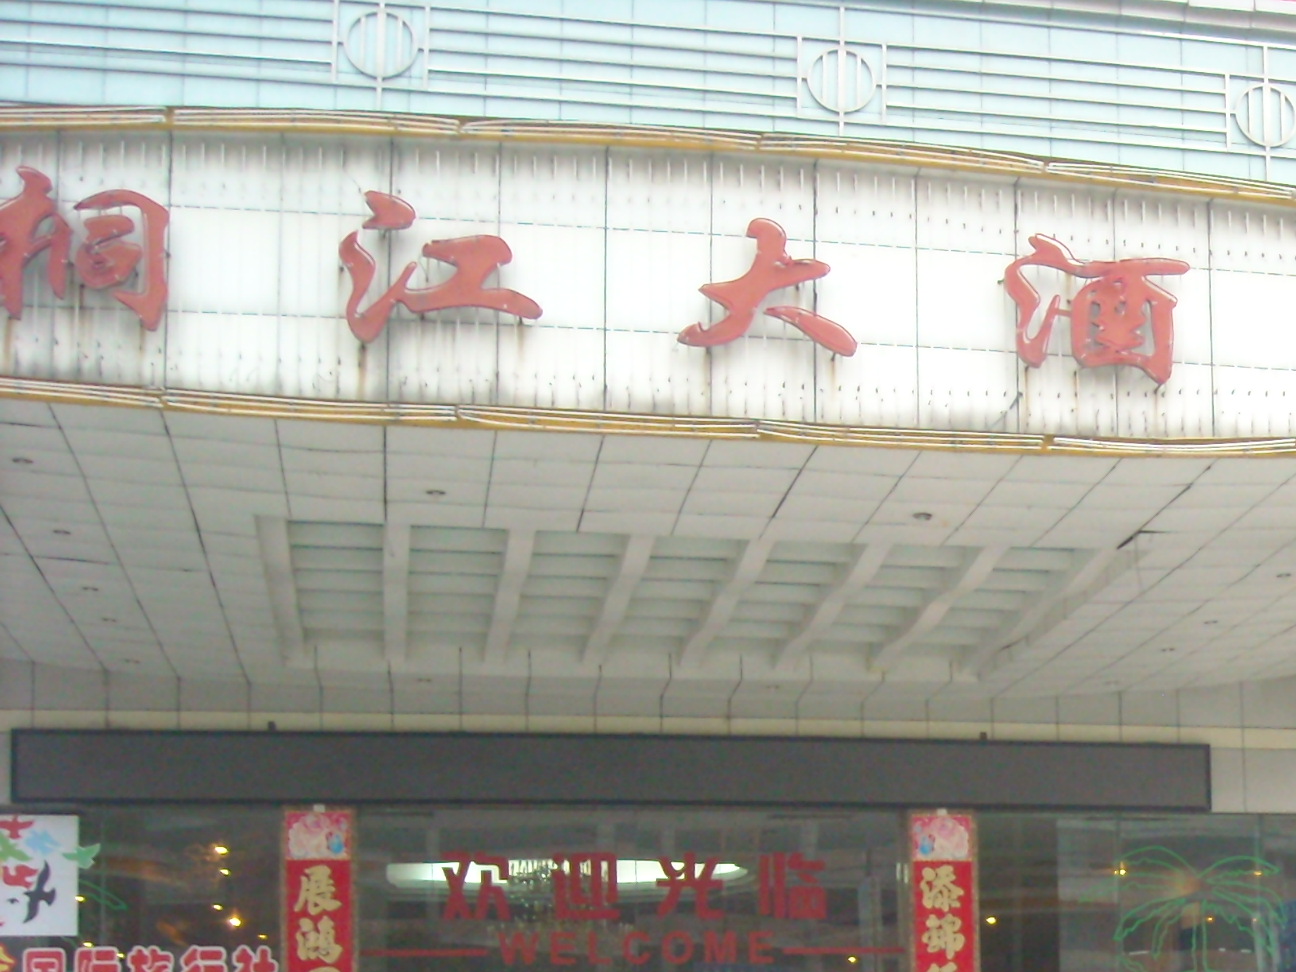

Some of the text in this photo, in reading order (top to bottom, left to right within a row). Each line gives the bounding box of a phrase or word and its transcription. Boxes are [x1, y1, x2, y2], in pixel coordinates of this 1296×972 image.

[441, 851, 827, 920] 欢迎光临
[499, 930, 775, 965] WELCOME
